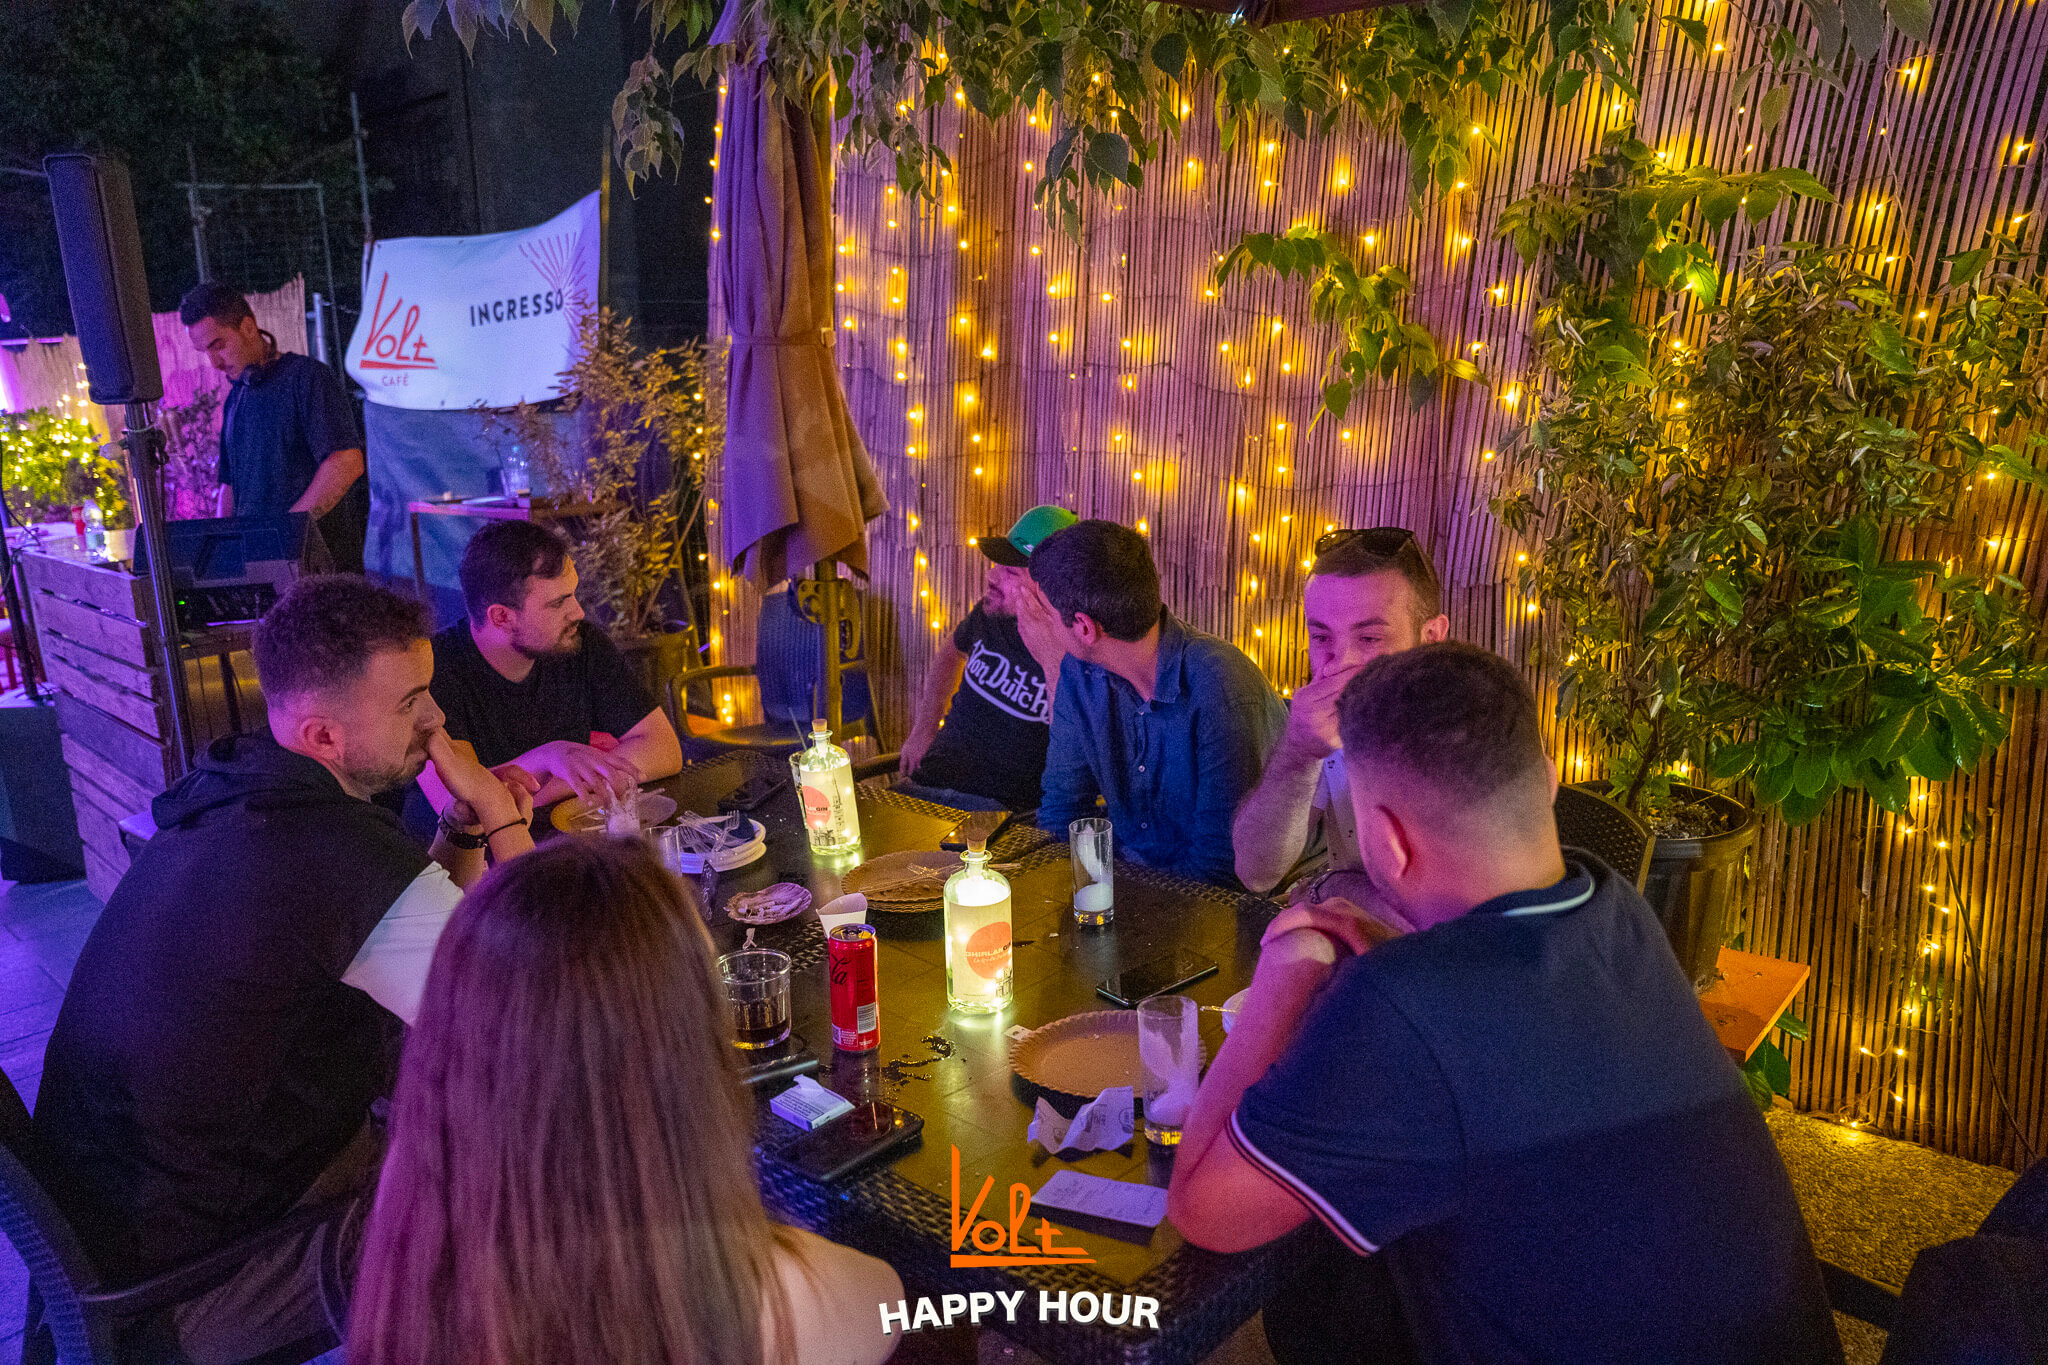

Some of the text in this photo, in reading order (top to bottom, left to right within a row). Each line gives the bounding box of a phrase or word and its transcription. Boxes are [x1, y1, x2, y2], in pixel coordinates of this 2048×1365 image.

[363, 271, 435, 363] Volt
[470, 288, 564, 327] INGRESSO
[382, 374, 409, 387] CAFÉ
